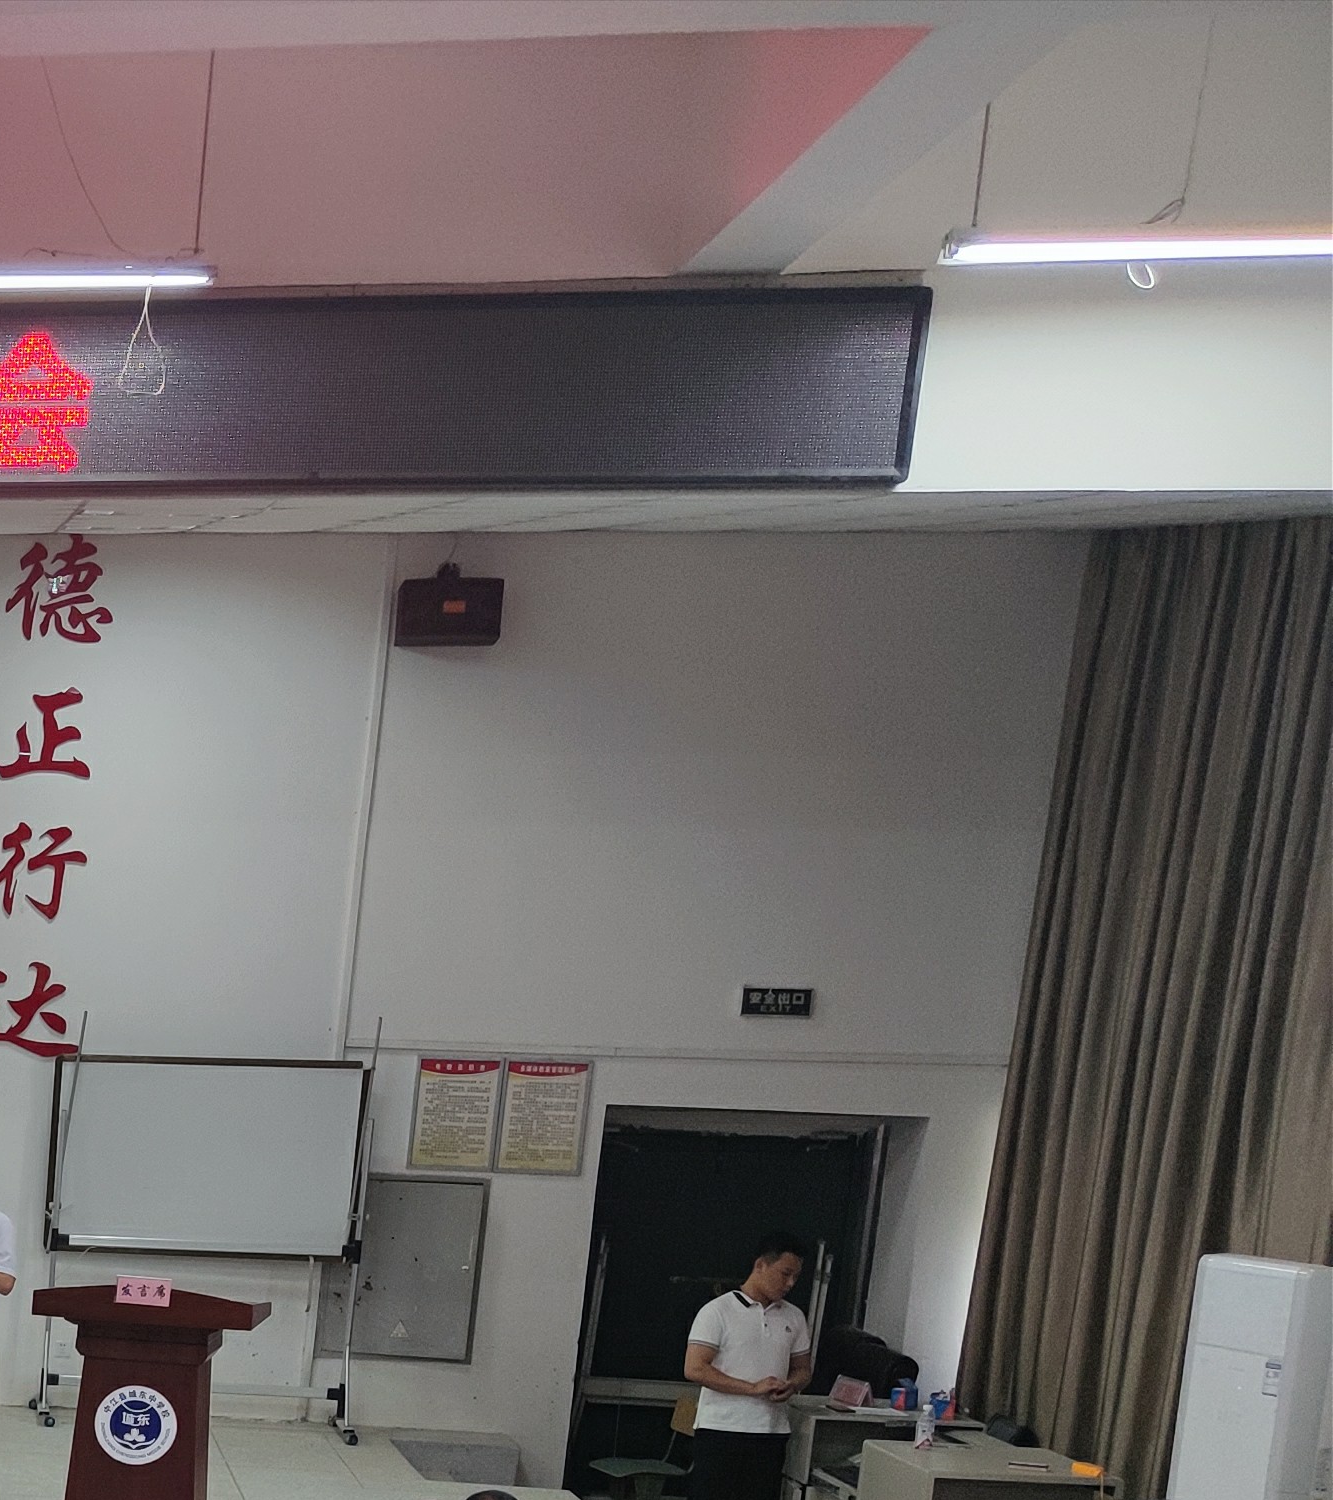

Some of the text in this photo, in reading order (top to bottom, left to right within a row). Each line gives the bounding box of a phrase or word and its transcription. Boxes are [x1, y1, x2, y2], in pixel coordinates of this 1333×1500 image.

[749, 990, 805, 1005] 安全出口
[760, 1004, 792, 1013] EXIT
[121, 1283, 167, 1300] 发言席
